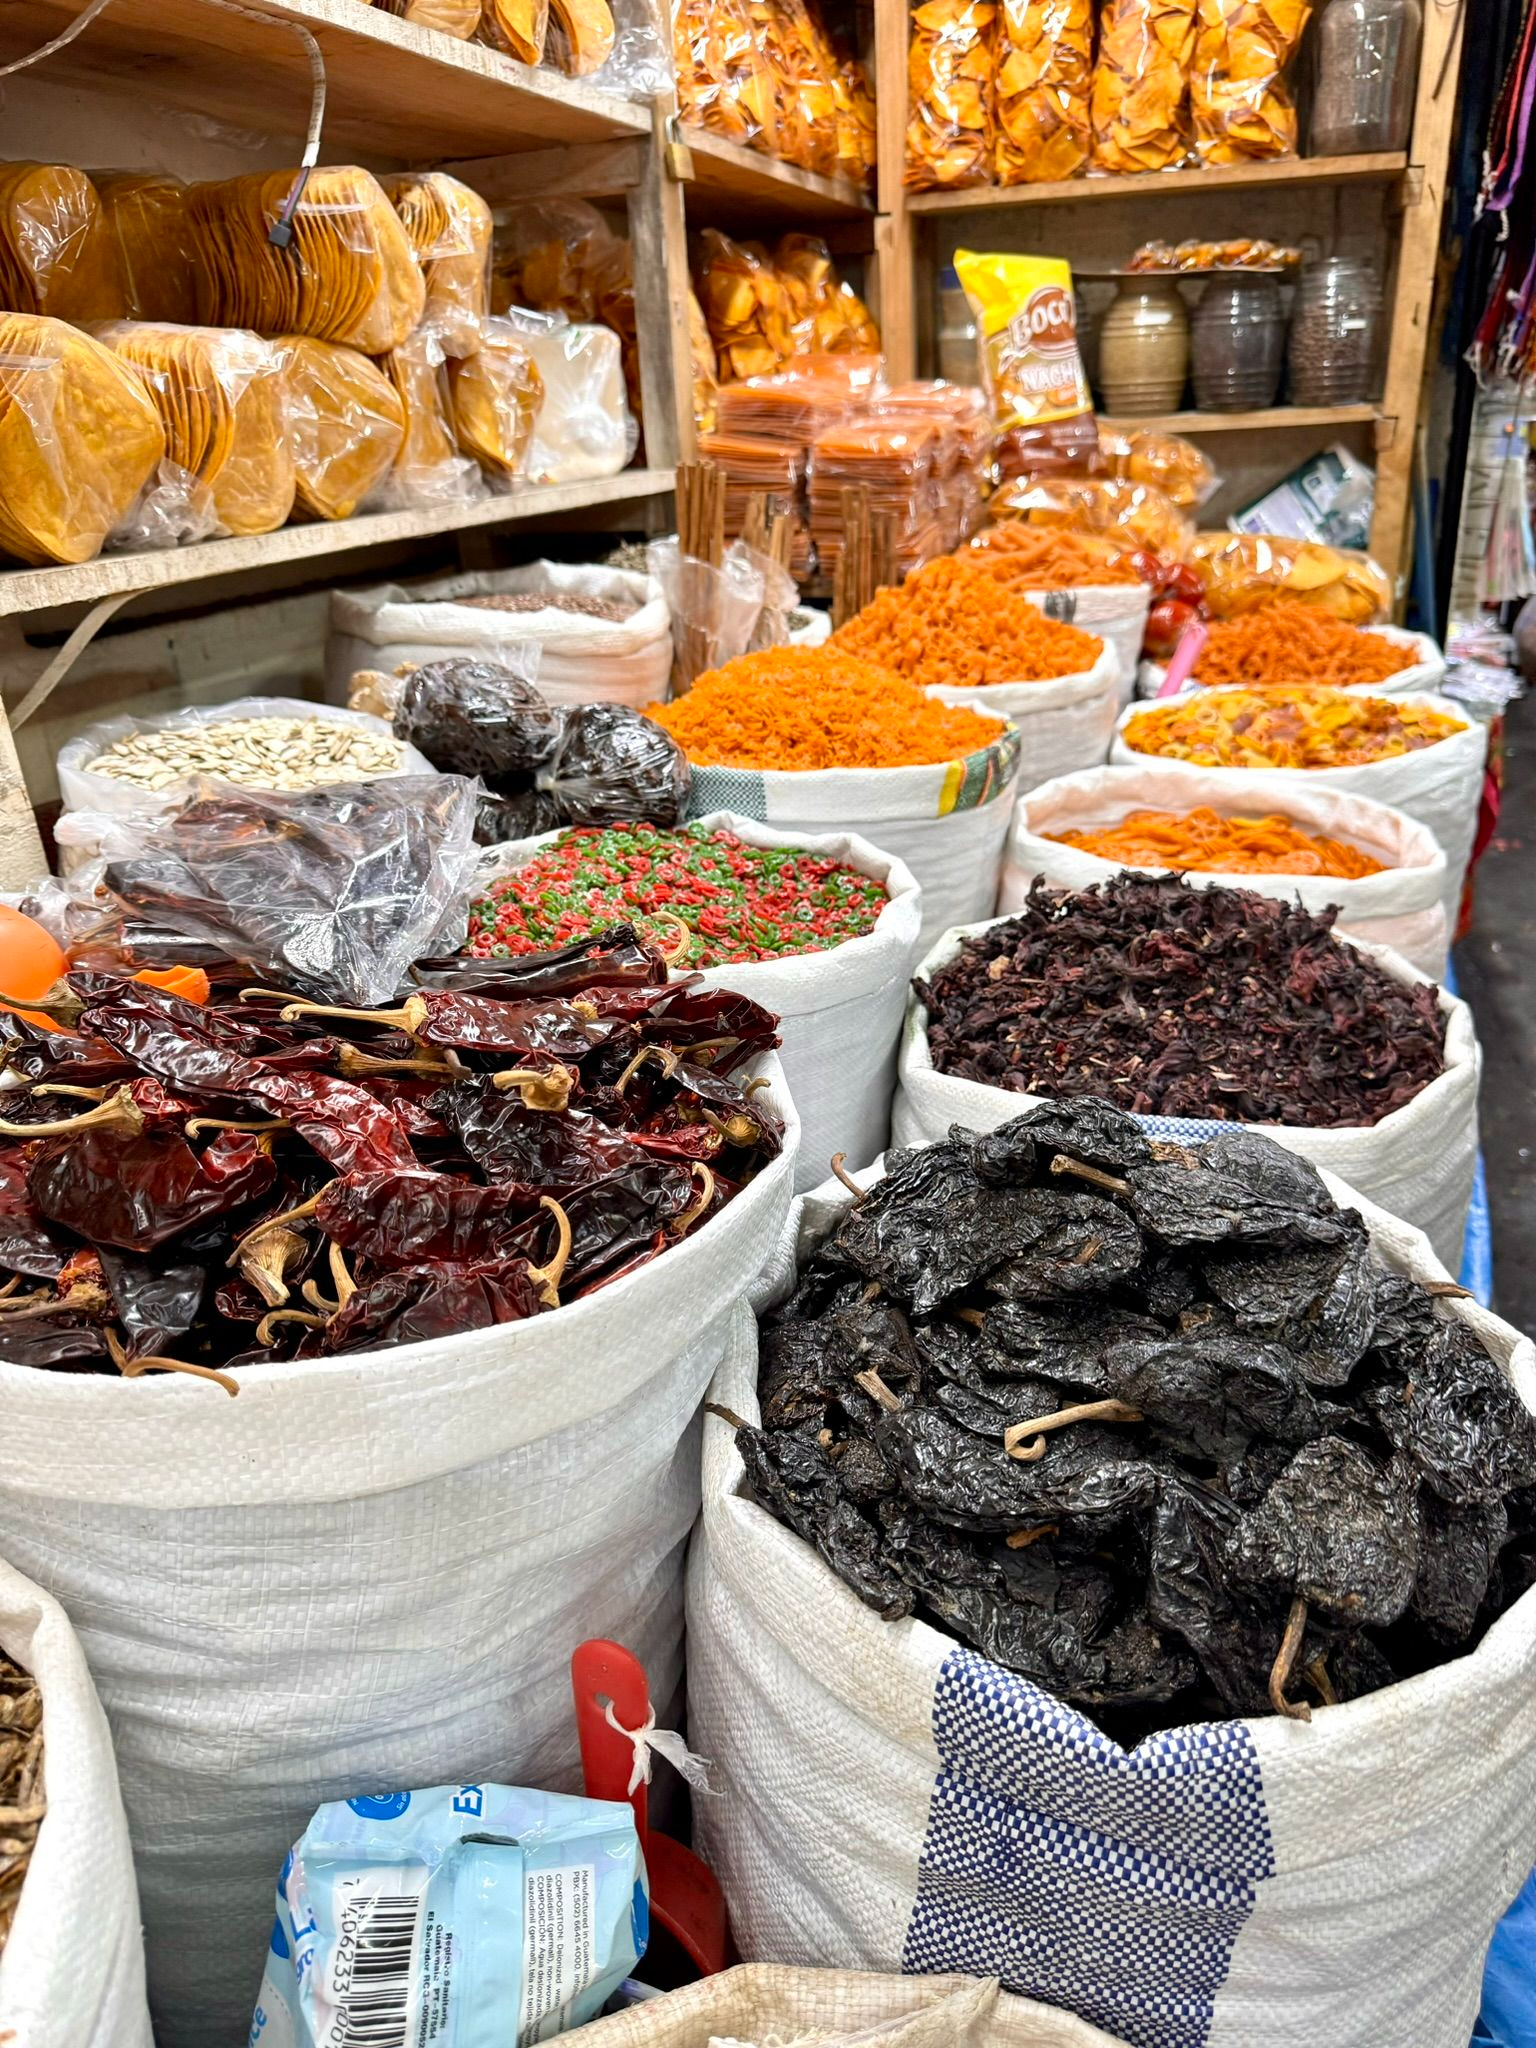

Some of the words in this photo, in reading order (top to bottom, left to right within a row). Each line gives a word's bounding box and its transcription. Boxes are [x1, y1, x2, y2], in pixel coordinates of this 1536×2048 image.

[427, 1911, 435, 1920] El
[537, 1876, 546, 1944] COMPOSICIÓN:
[555, 1874, 563, 1941] COMPOSITION:
[573, 1894, 581, 1918] (502)
[333, 1907, 359, 1992] 406233
[424, 1925, 434, 1971] Salvador
[444, 1933, 452, 1976] Registro
[537, 1947, 545, 1968] Agua
[527, 1985, 534, 1995] no
[528, 1969, 536, 1983] tela
[440, 1980, 450, 2029] Sanitario:
[526, 1998, 535, 2020] tejida
